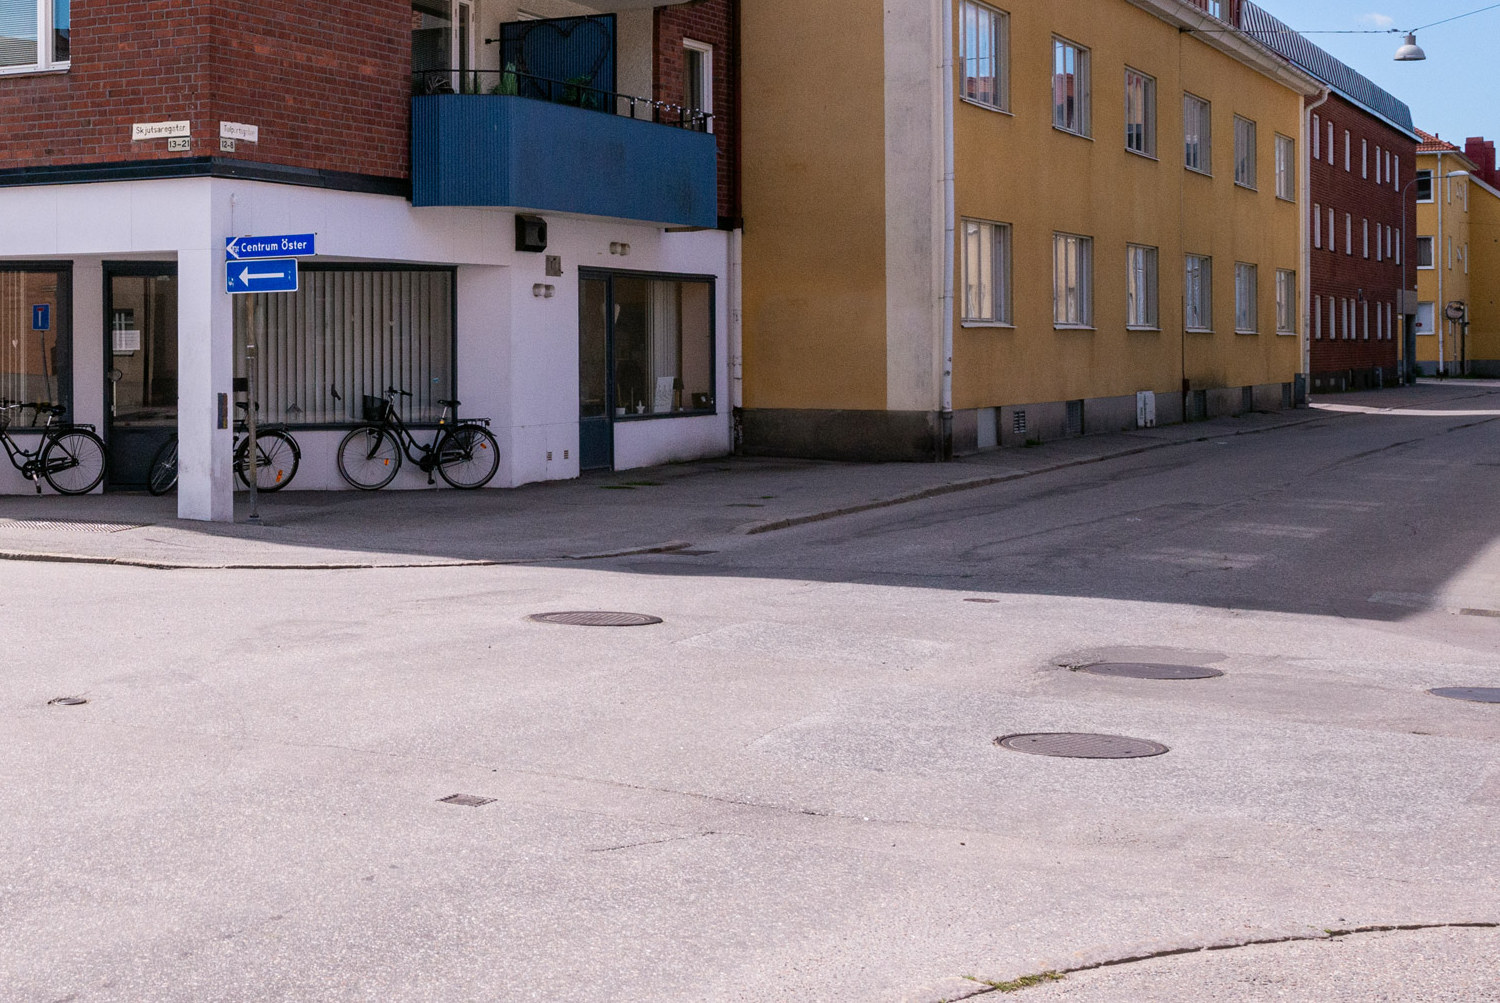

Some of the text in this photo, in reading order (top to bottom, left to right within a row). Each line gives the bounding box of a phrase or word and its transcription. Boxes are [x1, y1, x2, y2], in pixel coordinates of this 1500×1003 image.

[169, 140, 190, 148] 13-21
[241, 242, 278, 252] Centrum
[281, 238, 307, 250] Öster
